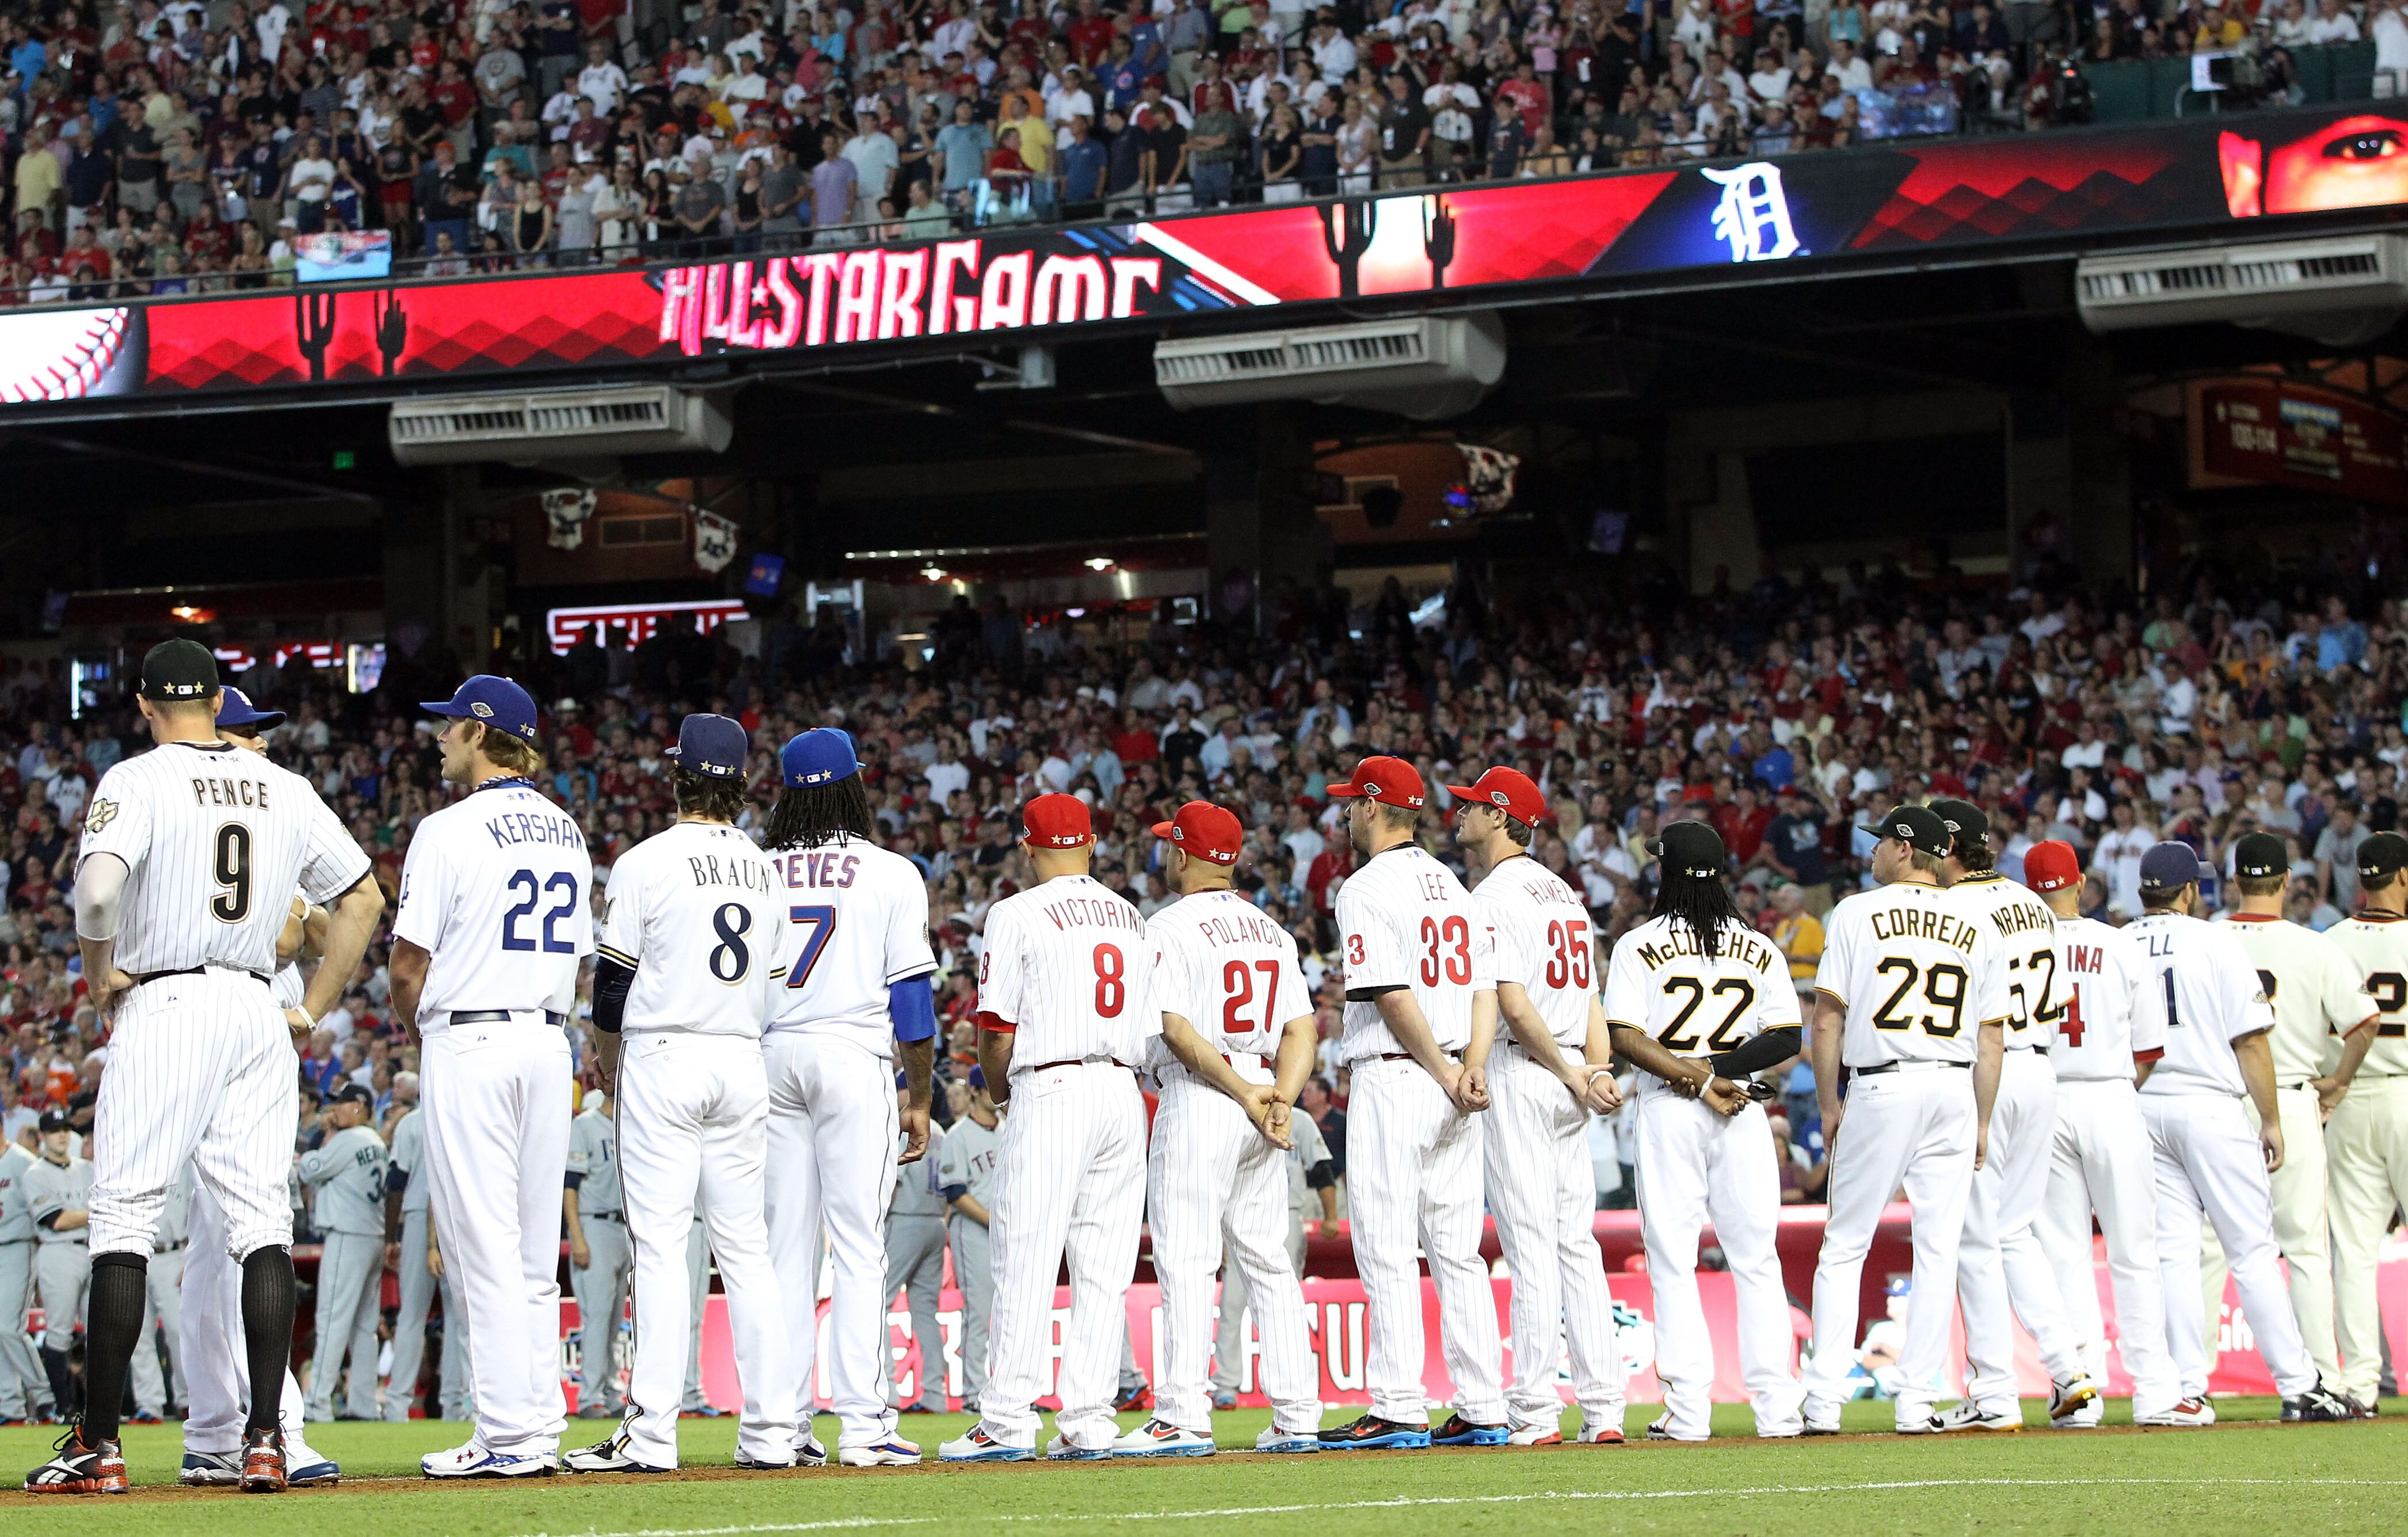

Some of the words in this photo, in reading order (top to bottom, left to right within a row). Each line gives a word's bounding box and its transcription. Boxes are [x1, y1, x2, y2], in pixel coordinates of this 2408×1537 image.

[190, 777, 269, 811] PENCE
[209, 821, 253, 924] 9
[687, 854, 772, 899] BRAUN
[1416, 873, 1448, 901] LEE
[502, 869, 578, 954] 22
[710, 902, 755, 987] 8
[1043, 899, 1145, 941] VICTORINO
[1199, 916, 1282, 948] POLANCO
[1871, 908, 1976, 954] CORREIA
[786, 904, 836, 988] 7
[1421, 915, 1472, 987] 33
[1546, 919, 1589, 989] 35
[1636, 928, 1772, 975] McCUCHEN
[2136, 933, 2174, 958] LL
[1093, 942, 1125, 1018] 8
[1224, 960, 1279, 1033] 27
[1870, 956, 1970, 1040] 29
[2158, 964, 2185, 1028] 1
[1657, 975, 1756, 1053] 22
[2059, 982, 2086, 1048] 4
[250, 1446, 278, 1457] Reebok
